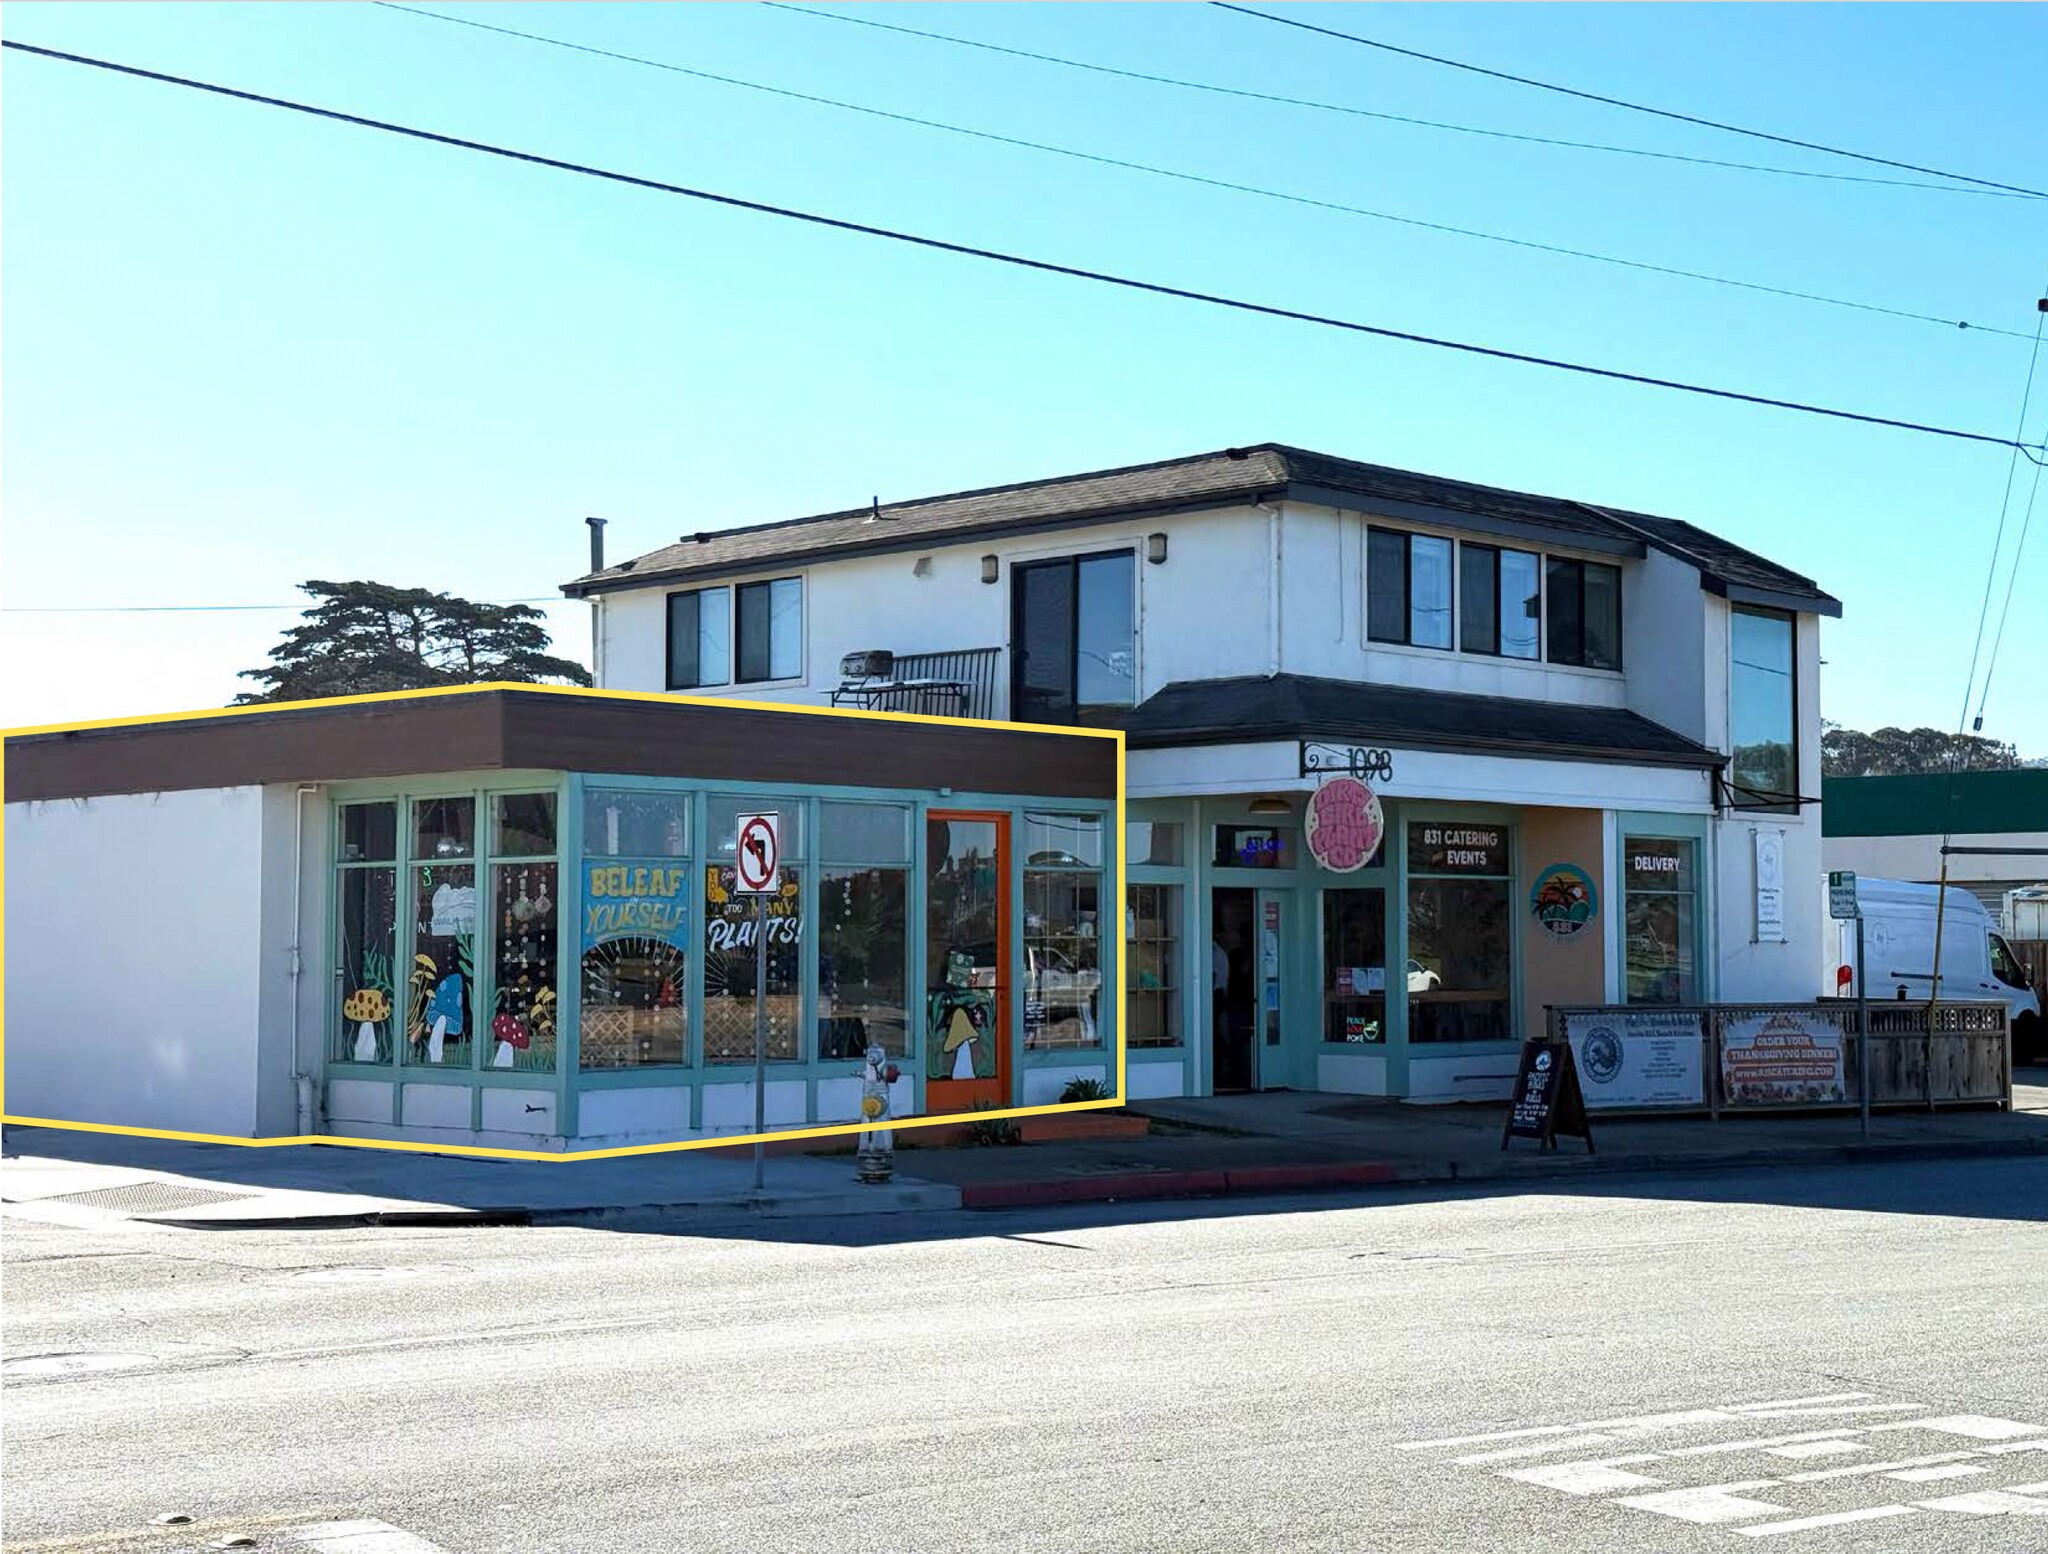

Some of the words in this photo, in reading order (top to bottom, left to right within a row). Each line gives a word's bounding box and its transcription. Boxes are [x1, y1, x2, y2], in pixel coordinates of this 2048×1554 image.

[1347, 748, 1392, 782] 1098
[1423, 828, 1442, 845] 831
[1444, 830, 1498, 846] CATERING
[1447, 850, 1488, 865] EVENTS
[1634, 855, 1680, 871] DELIVERY
[590, 866, 685, 898] BELEAF
[585, 902, 687, 934] YOURSELF
[727, 904, 743, 914] TOO
